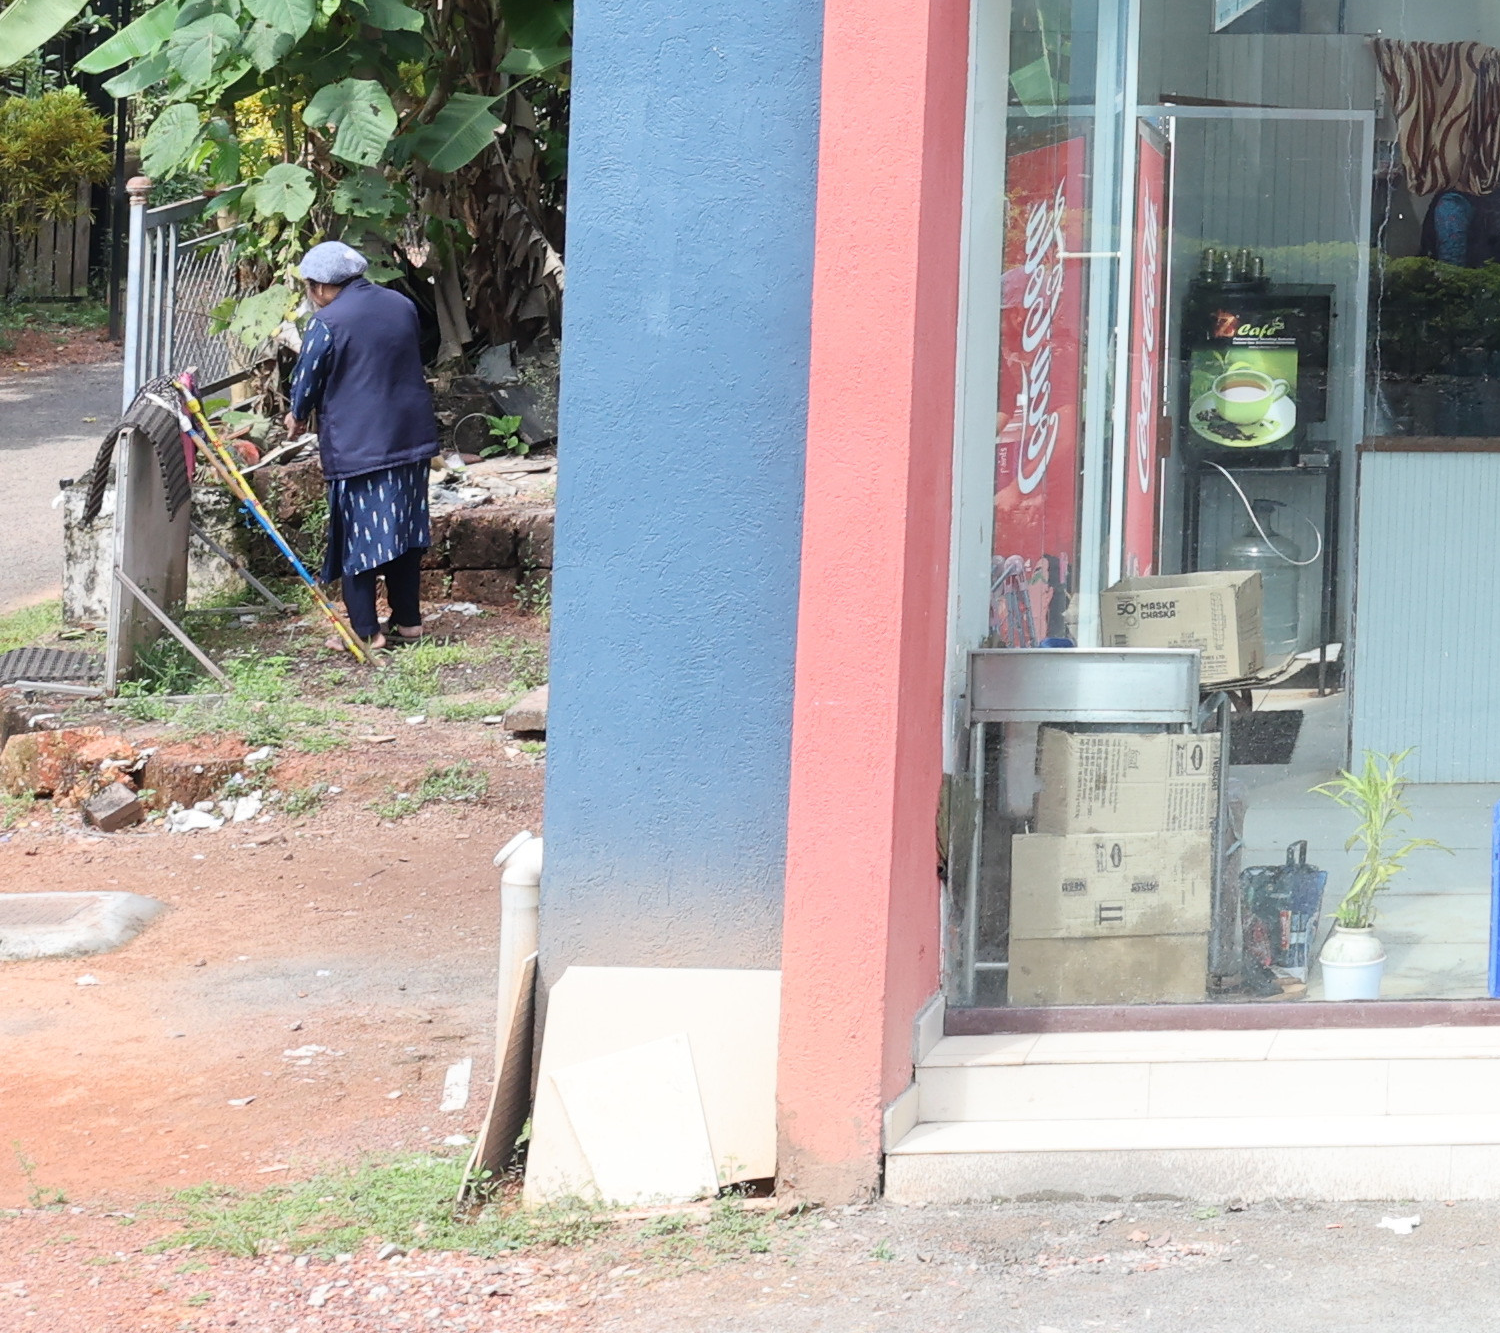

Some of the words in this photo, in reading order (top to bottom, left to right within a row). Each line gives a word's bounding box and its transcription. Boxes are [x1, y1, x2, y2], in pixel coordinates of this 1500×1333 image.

[1116, 603, 1136, 616] 50
[1141, 600, 1176, 611] MASKA
[1140, 610, 1176, 620] CHASKA
